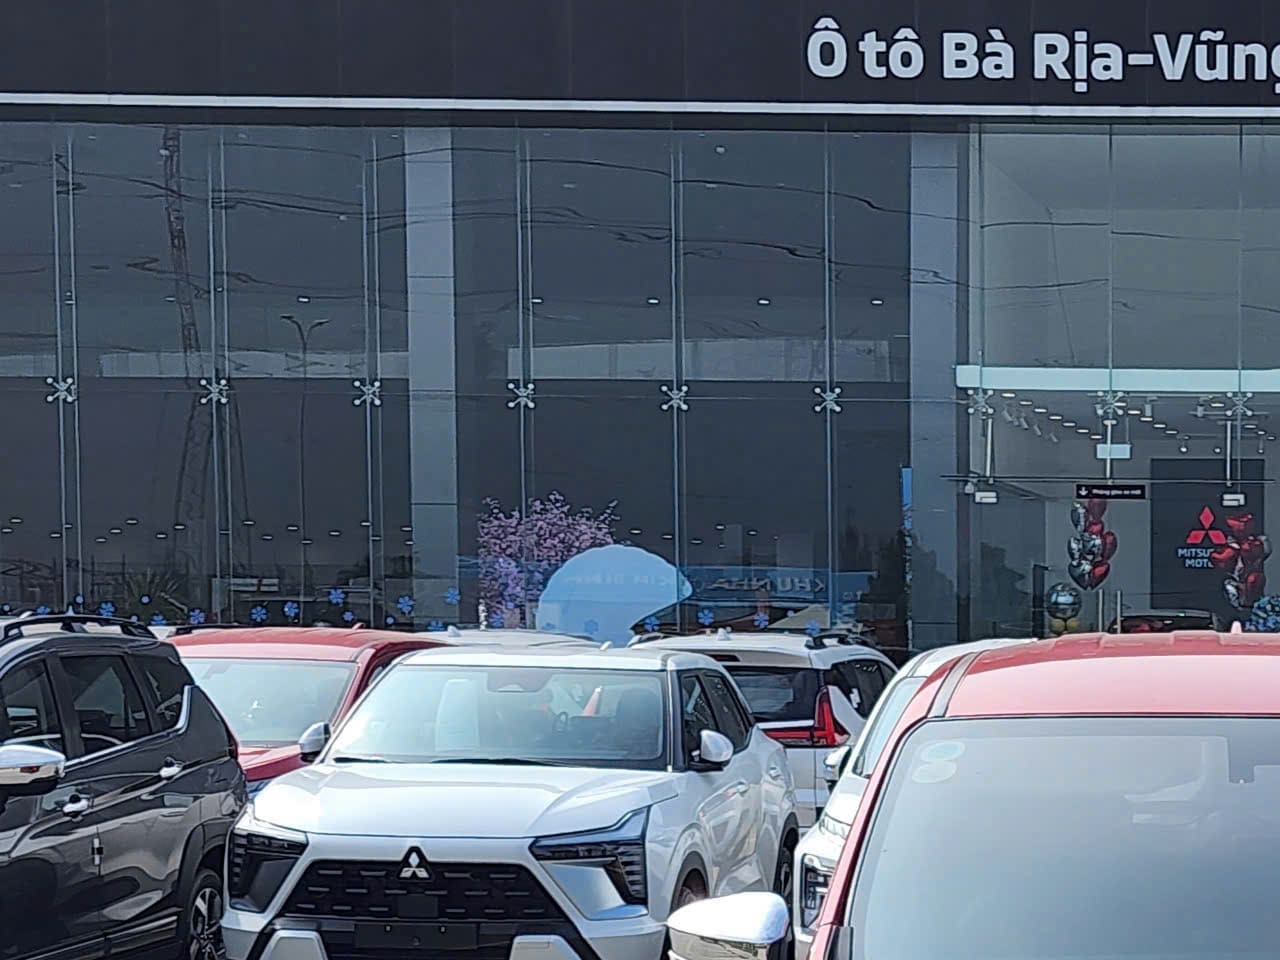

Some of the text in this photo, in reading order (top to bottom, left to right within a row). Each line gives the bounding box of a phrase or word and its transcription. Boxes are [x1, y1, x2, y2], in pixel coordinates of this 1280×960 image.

[807, 17, 847, 78] Ô
[858, 27, 924, 79] tô
[943, 28, 1015, 80] Bà
